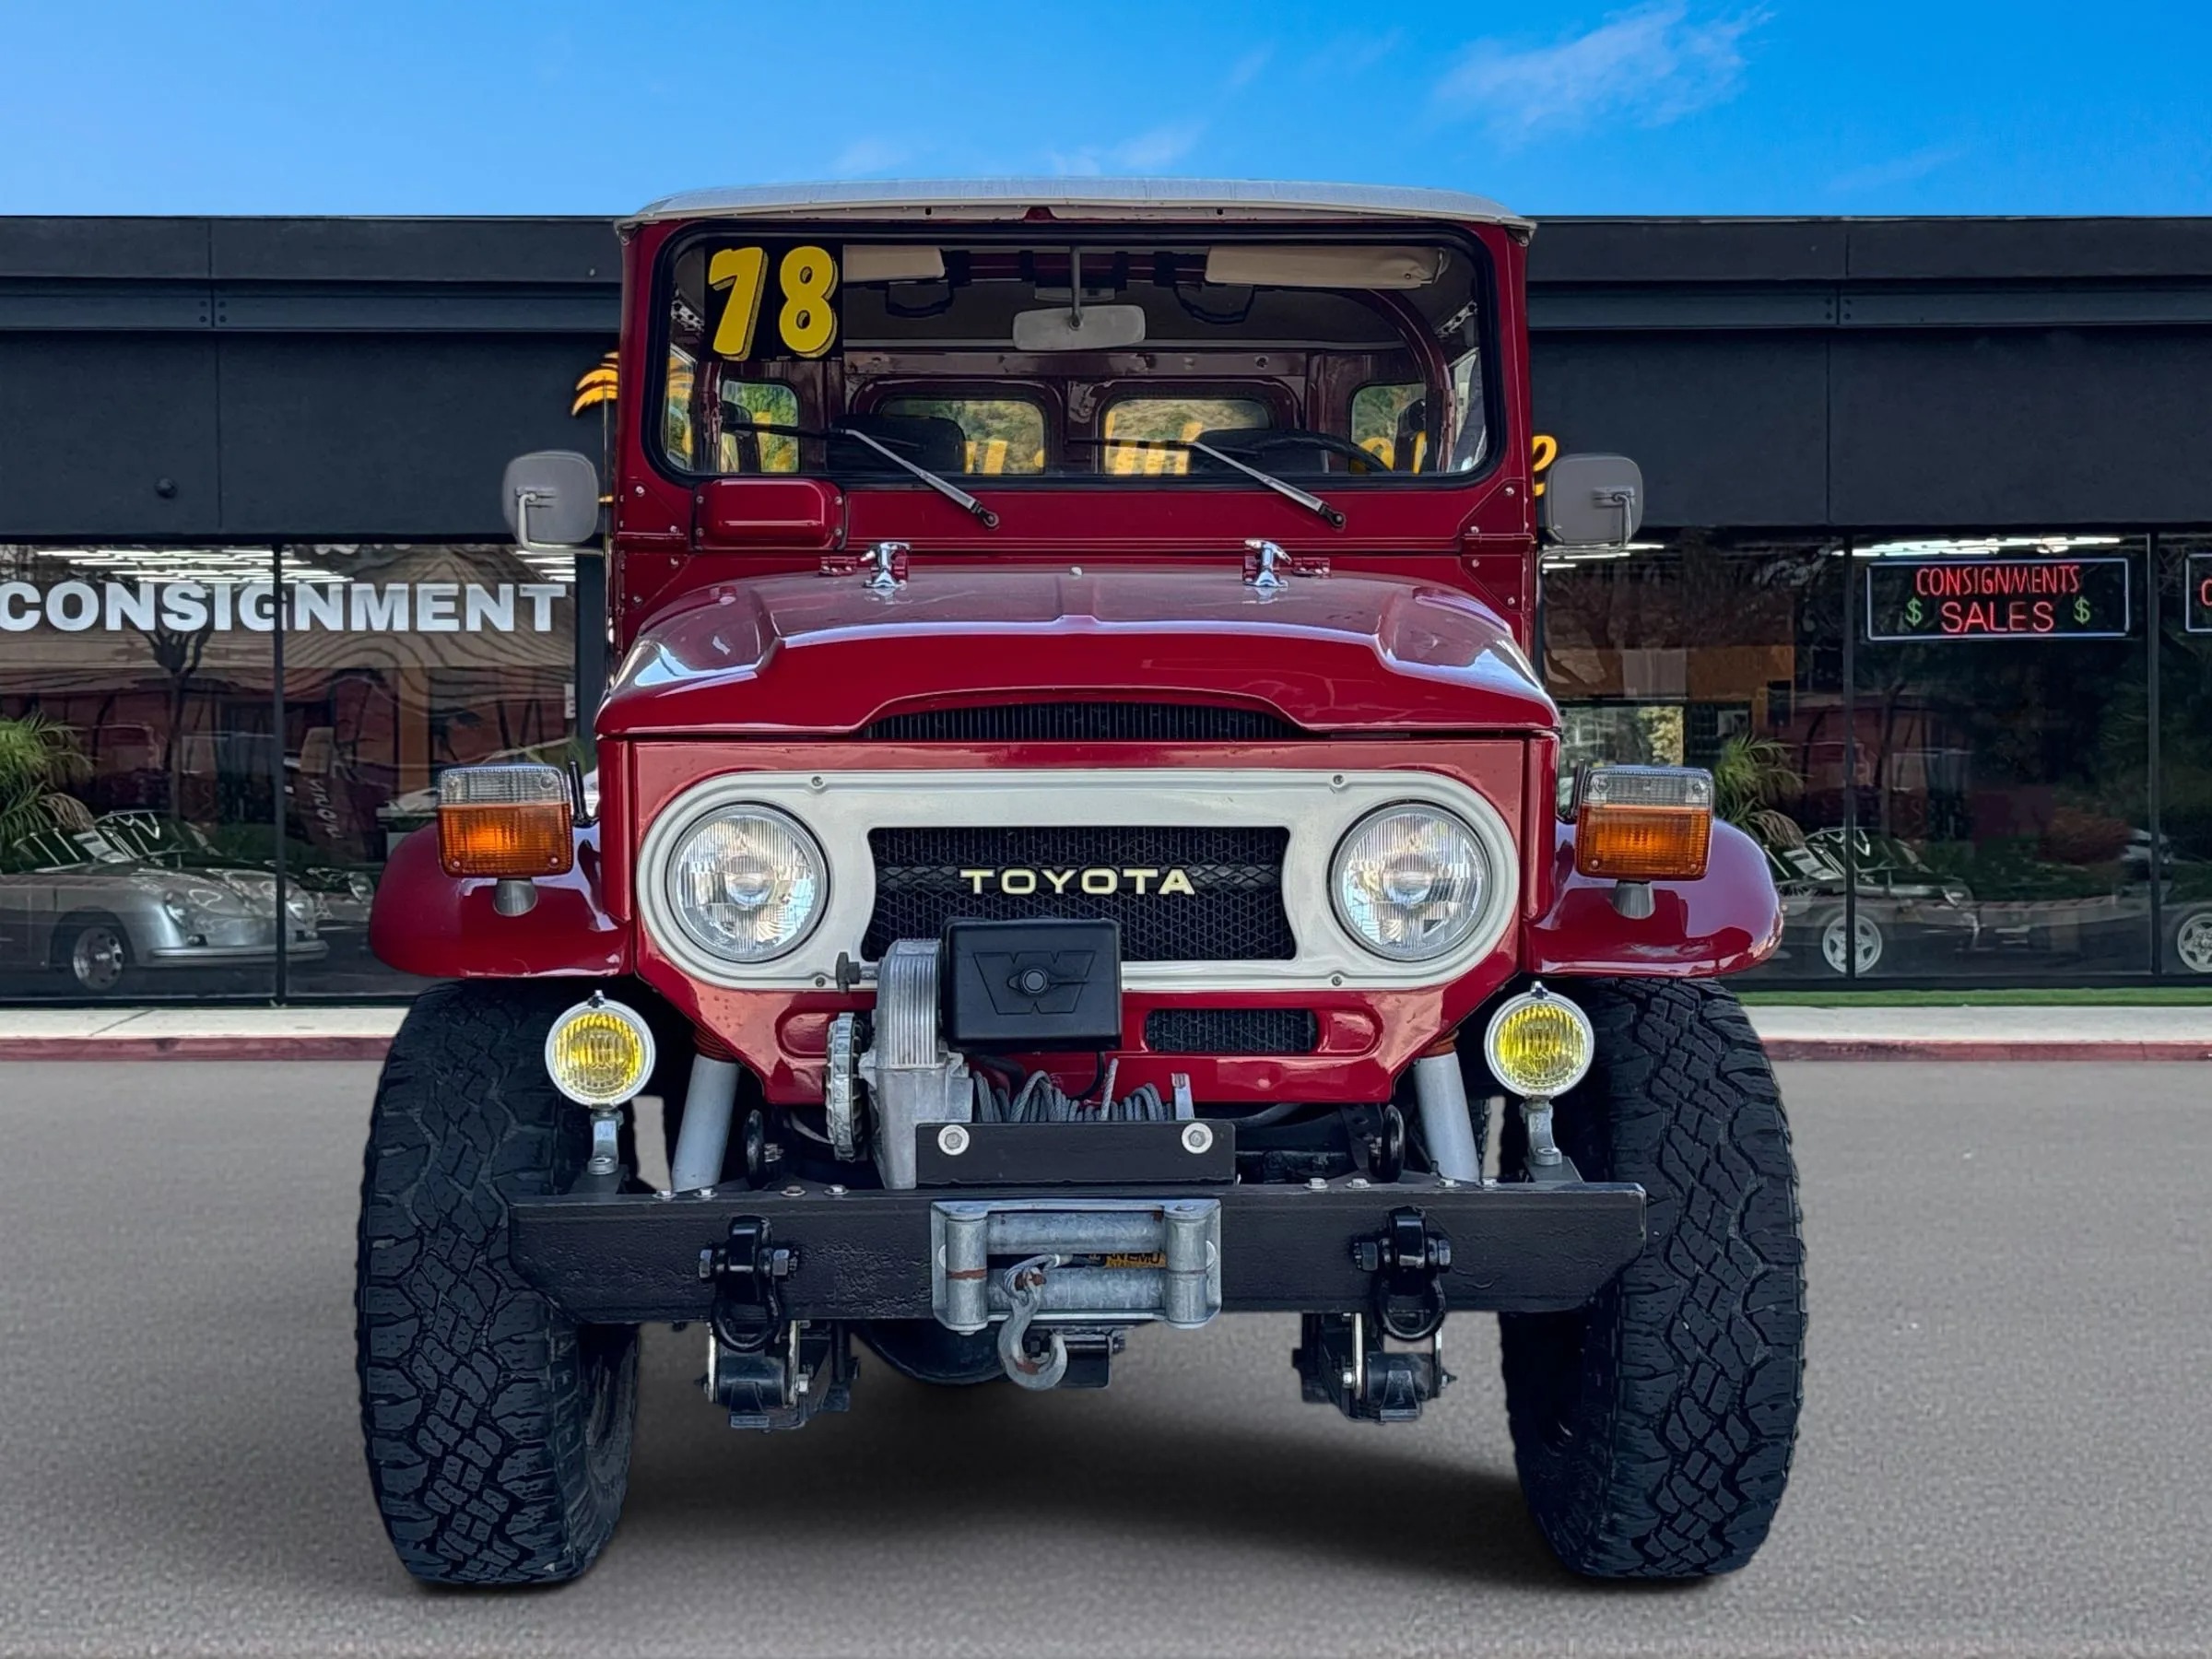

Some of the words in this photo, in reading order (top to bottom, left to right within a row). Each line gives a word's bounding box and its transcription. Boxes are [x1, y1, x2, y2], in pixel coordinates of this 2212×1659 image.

[708, 246, 838, 361] 78
[1916, 565, 2080, 596] CONSIGNMENTS
[0, 582, 565, 632] CONSIGNMENT
[1941, 601, 2054, 633] SALES
[959, 868, 1195, 895] TOYOTA
